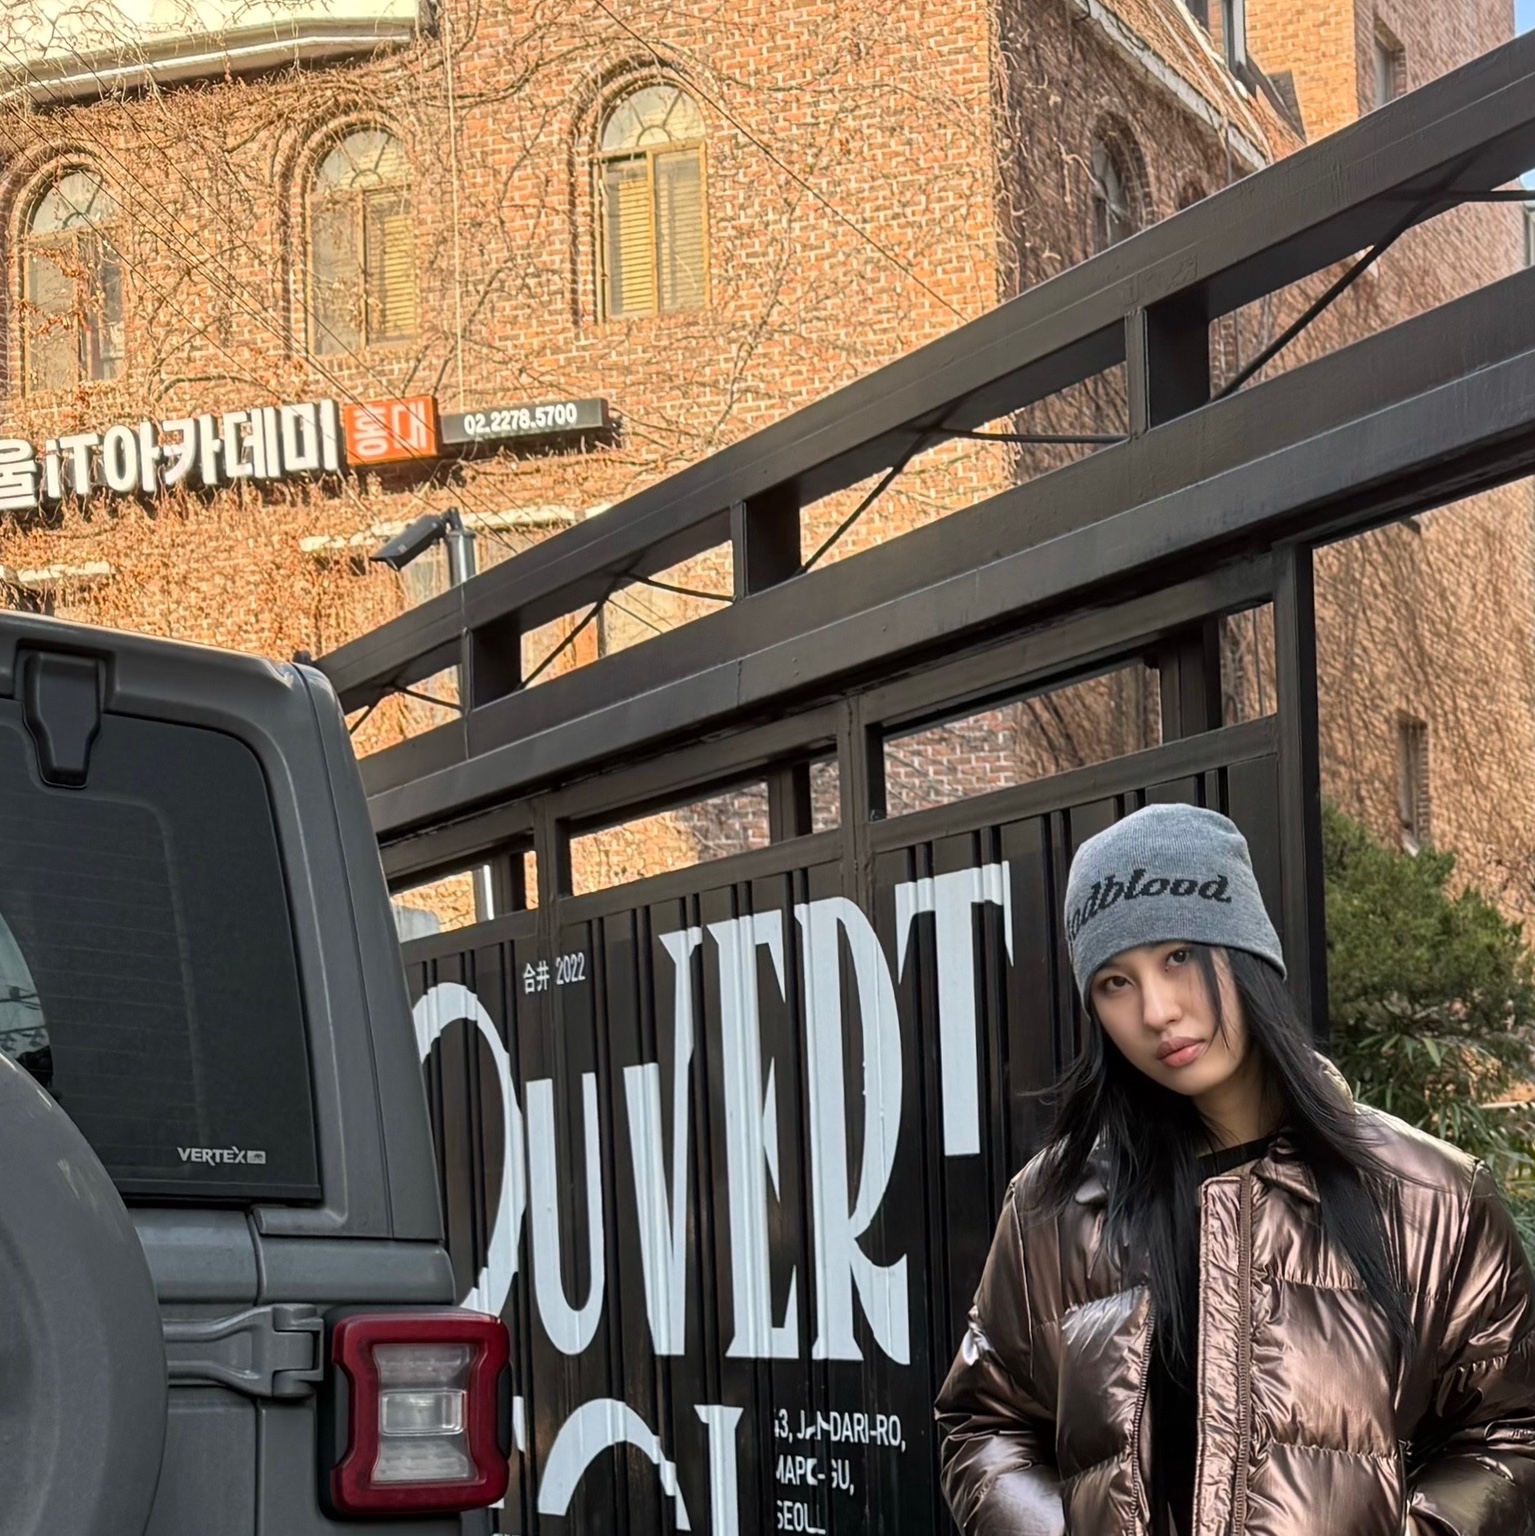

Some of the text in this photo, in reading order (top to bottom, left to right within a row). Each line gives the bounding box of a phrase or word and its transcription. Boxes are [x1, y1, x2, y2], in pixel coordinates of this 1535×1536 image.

[463, 402, 578, 436] 02.2278.5700
[556, 952, 586, 985] 2022
[177, 1145, 246, 1167] VERTEX
